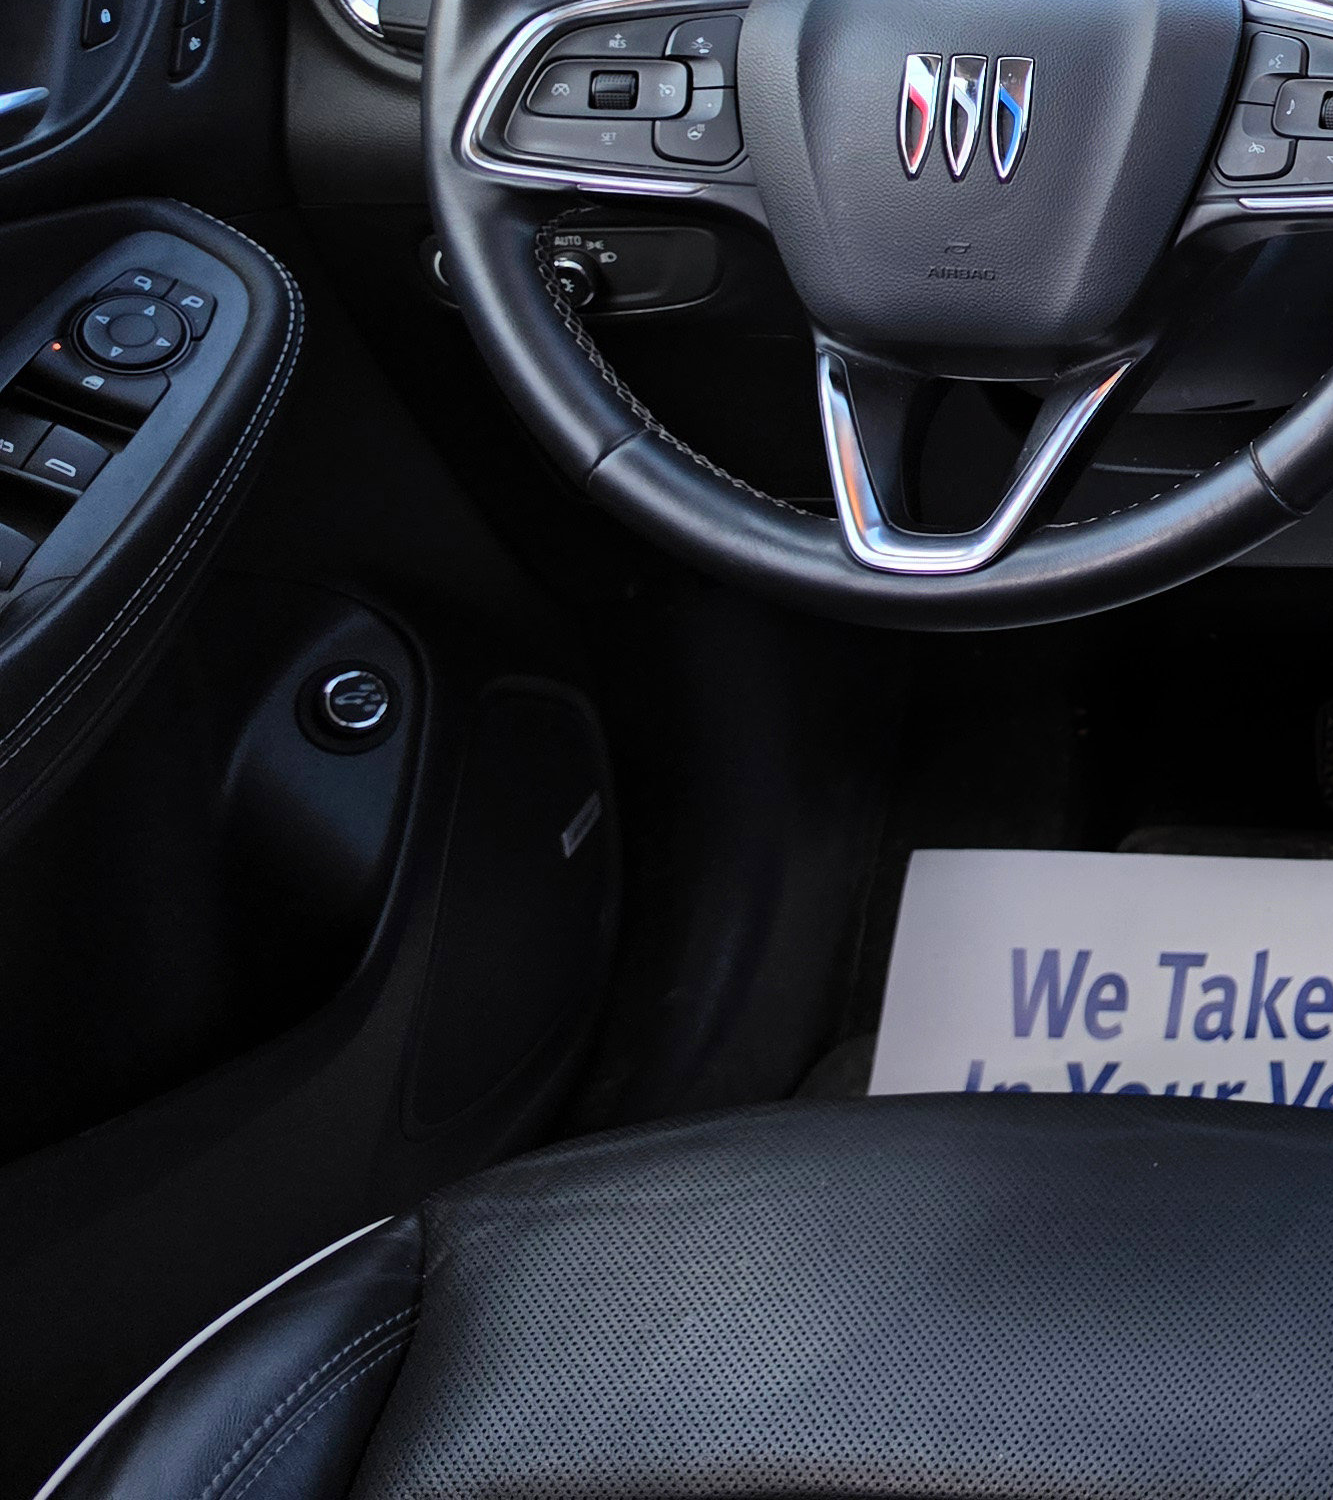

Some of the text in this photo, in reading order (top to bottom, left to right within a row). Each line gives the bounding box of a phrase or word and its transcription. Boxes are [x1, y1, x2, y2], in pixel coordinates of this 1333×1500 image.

[608, 39, 627, 48] RES
[601, 132, 617, 141] SET
[554, 235, 582, 246] AUTO
[1011, 947, 1130, 1041] We
